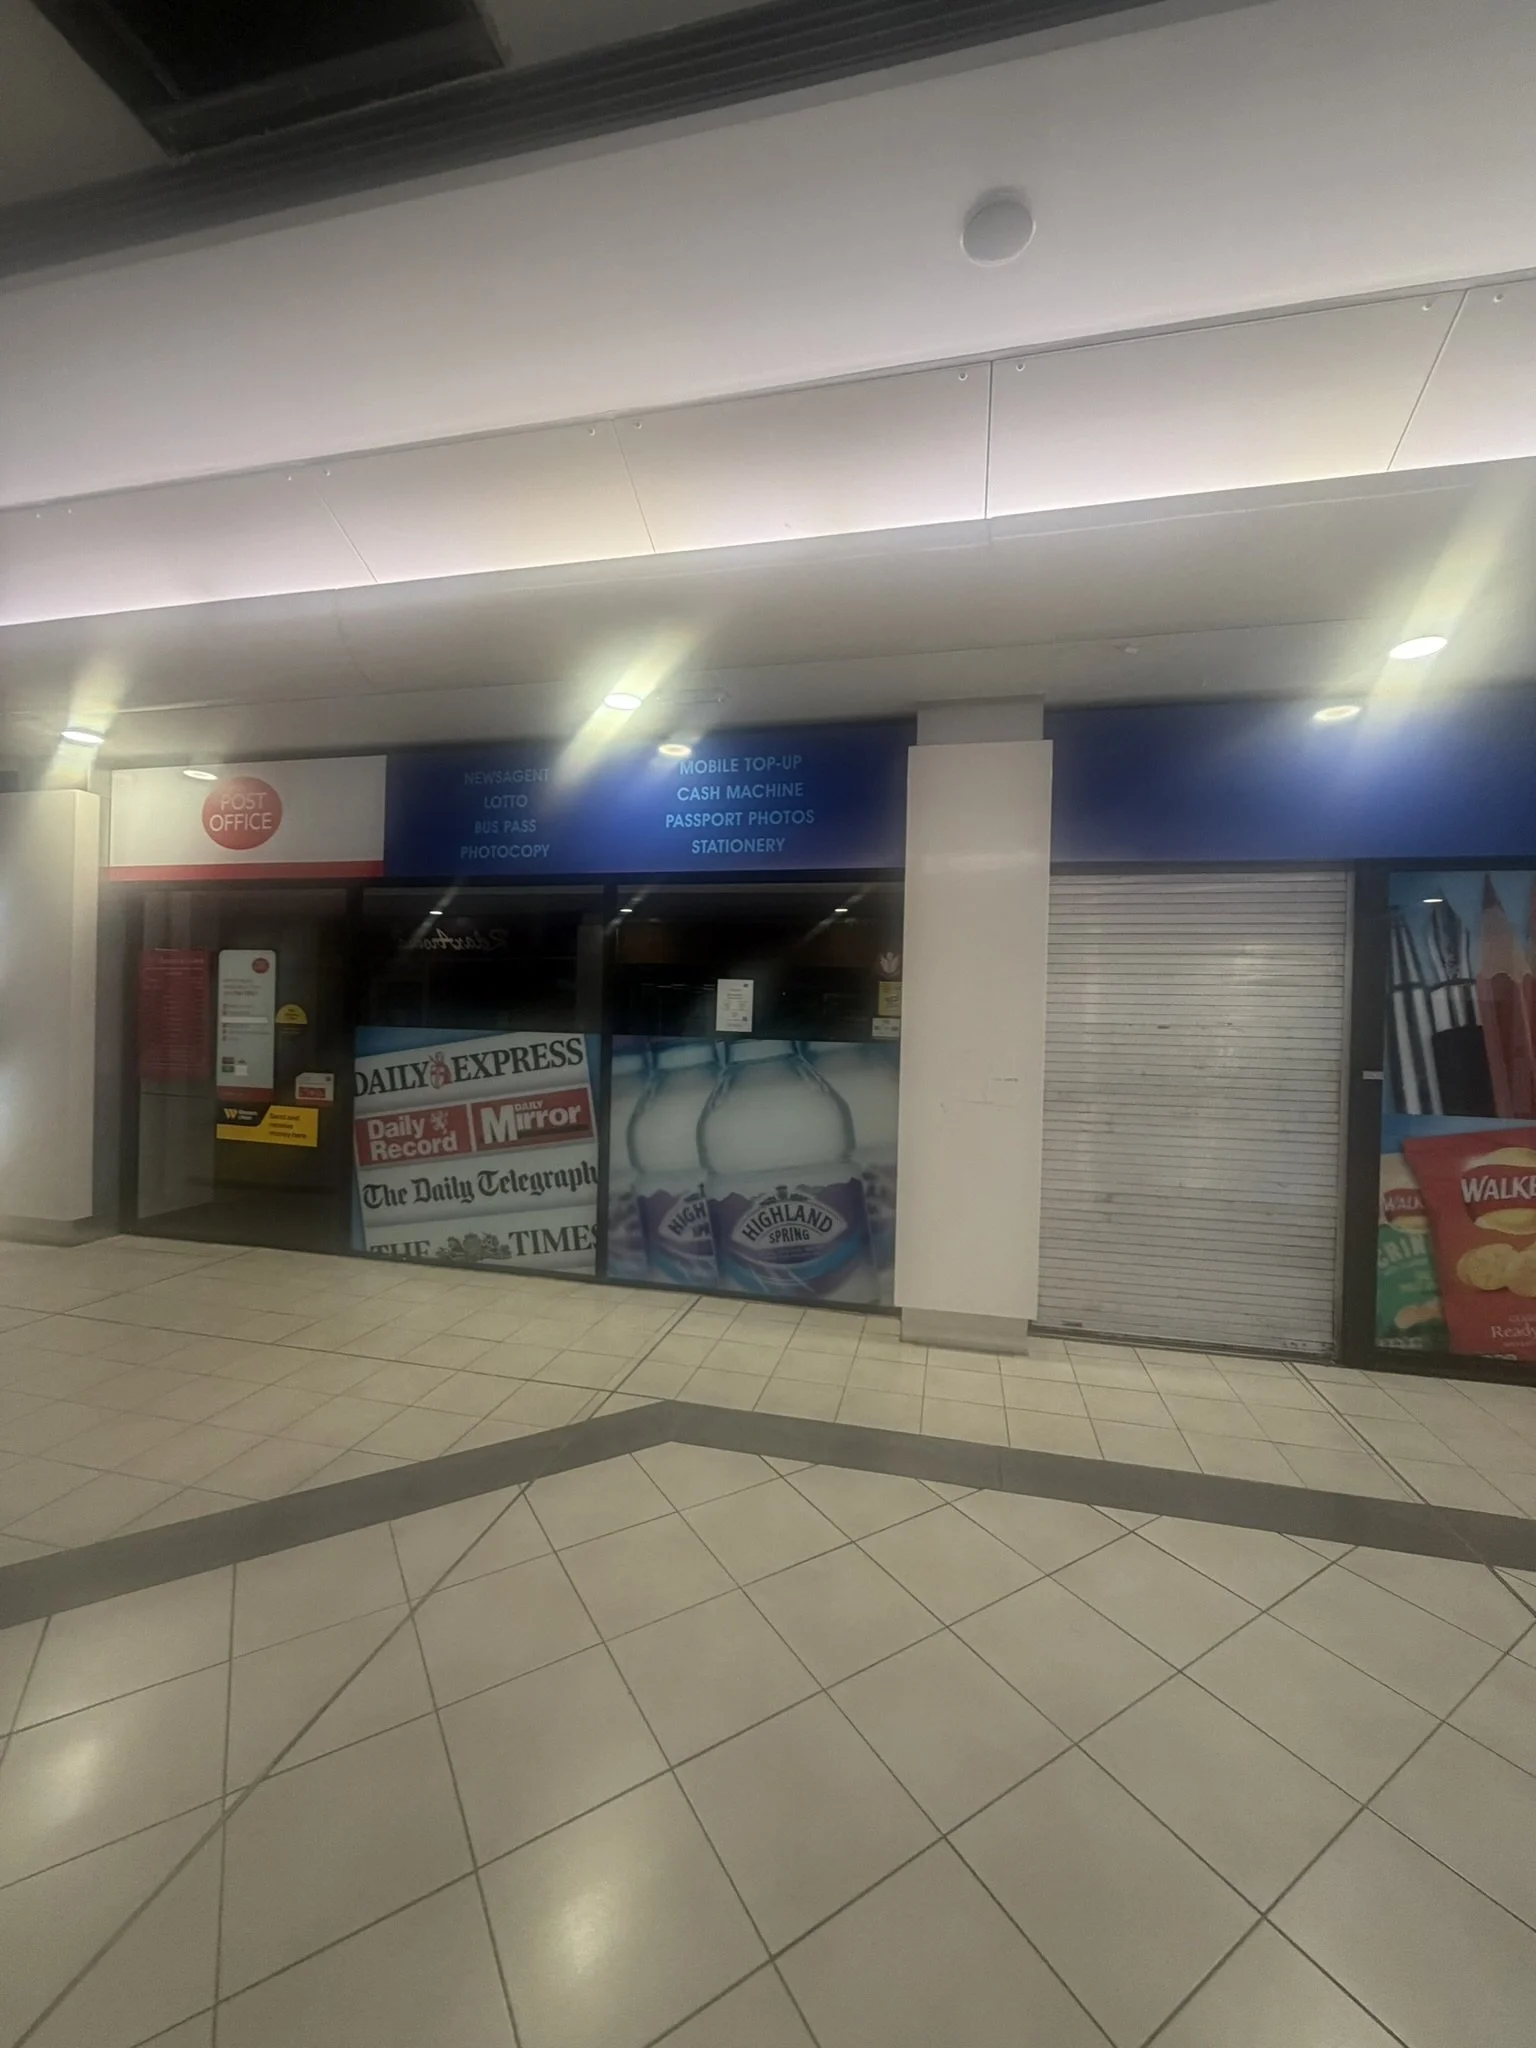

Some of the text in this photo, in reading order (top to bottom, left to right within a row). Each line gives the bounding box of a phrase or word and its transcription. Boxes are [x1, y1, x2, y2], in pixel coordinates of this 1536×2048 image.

[679, 755, 802, 775] MOBILE TOP-UP
[464, 768, 549, 786] NEWSAGENT
[221, 792, 268, 811] POST
[677, 783, 804, 801] CASH MACHINE
[484, 794, 528, 810] LOTTO
[209, 812, 272, 832] OFFICE
[474, 819, 537, 835] BUS PASS
[666, 810, 815, 828] PASSPORT PHOTOS
[460, 844, 550, 861] PHOTOCOPY
[691, 838, 785, 854] STATIONERY
[354, 1037, 584, 1098] DAILY EXPRESS
[367, 1115, 425, 1141] Daily
[480, 1103, 582, 1145] Mirror
[370, 1131, 458, 1162] Record
[362, 1160, 598, 1210] The Daily Telegraph
[668, 1201, 707, 1236] HIGH
[742, 1203, 833, 1242] HIGHLAND
[768, 1226, 810, 1245] SPRING
